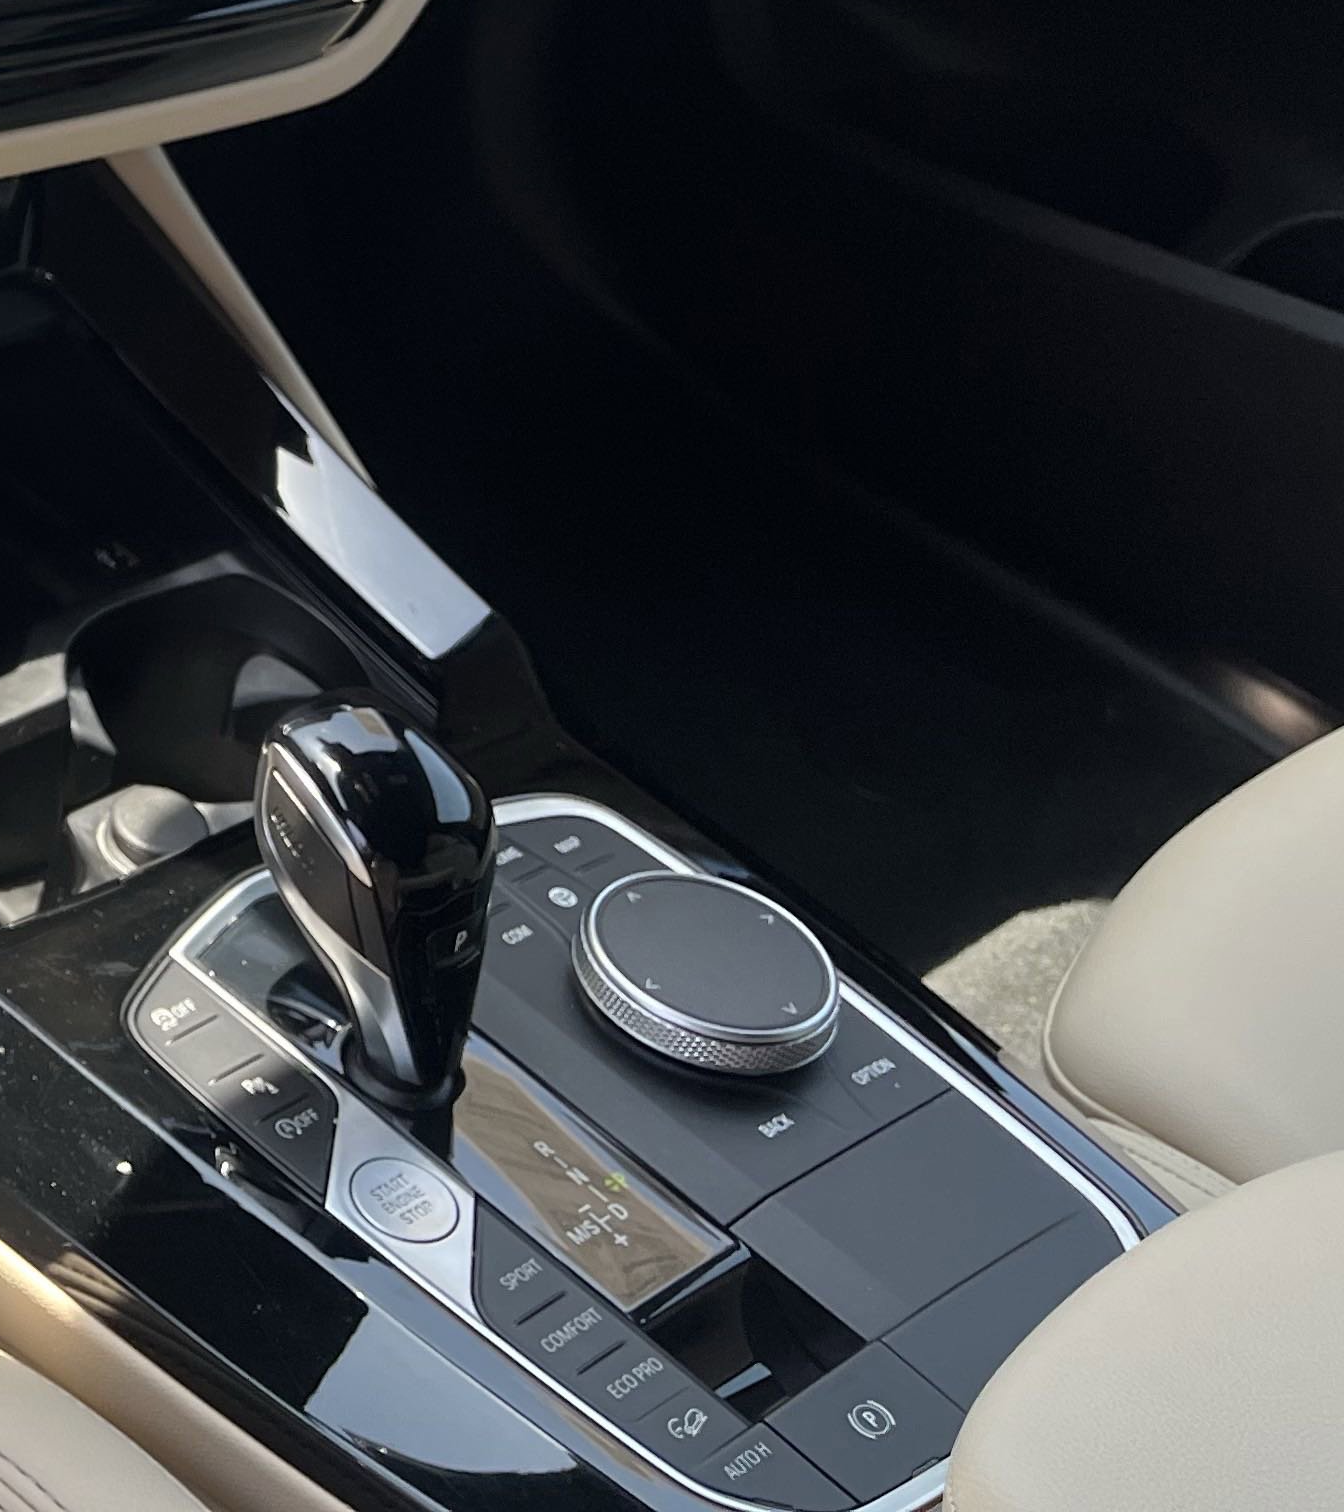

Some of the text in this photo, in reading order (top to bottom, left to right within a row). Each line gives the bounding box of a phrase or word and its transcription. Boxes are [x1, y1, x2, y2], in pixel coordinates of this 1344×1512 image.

[454, 930, 468, 953] P
[533, 1140, 555, 1158] R
[370, 1172, 410, 1202] START
[566, 1167, 591, 1186] N
[381, 1185, 426, 1215] ENGINE
[399, 1199, 433, 1225] STOP
[607, 1203, 629, 1221] D
[499, 1258, 543, 1291] SPORT
[540, 1306, 603, 1353] COMFORT
[606, 1357, 664, 1400] ECO PRO
[723, 1441, 773, 1481] AUTO H
